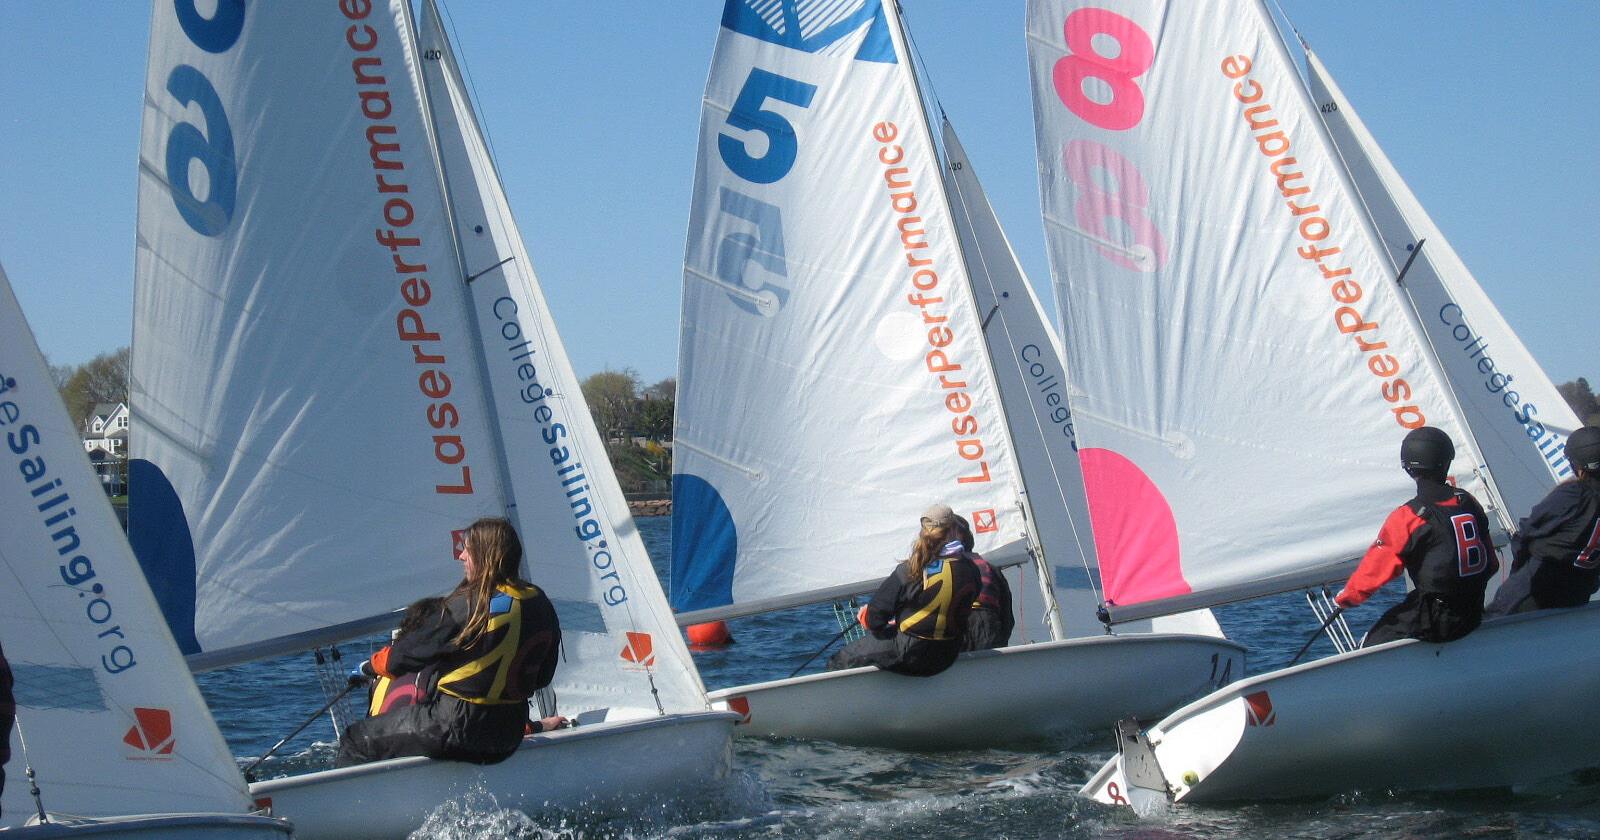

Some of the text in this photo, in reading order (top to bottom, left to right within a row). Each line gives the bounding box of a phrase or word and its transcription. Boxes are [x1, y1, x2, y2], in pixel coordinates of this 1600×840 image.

[424, 50, 441, 60] 420
[1052, 7, 1154, 131] 8
[1321, 102, 1338, 113] 420
[718, 67, 818, 184] 5
[949, 162, 962, 170] 20
[339, 0, 473, 494] LaserPerformance
[873, 121, 991, 484] LaserPerformance
[1221, 55, 1426, 430] aserPerformance
[493, 296, 628, 606] CollegeSailing.org
[0, 373, 137, 675] eSailing.org
[1451, 513, 1488, 577] B
